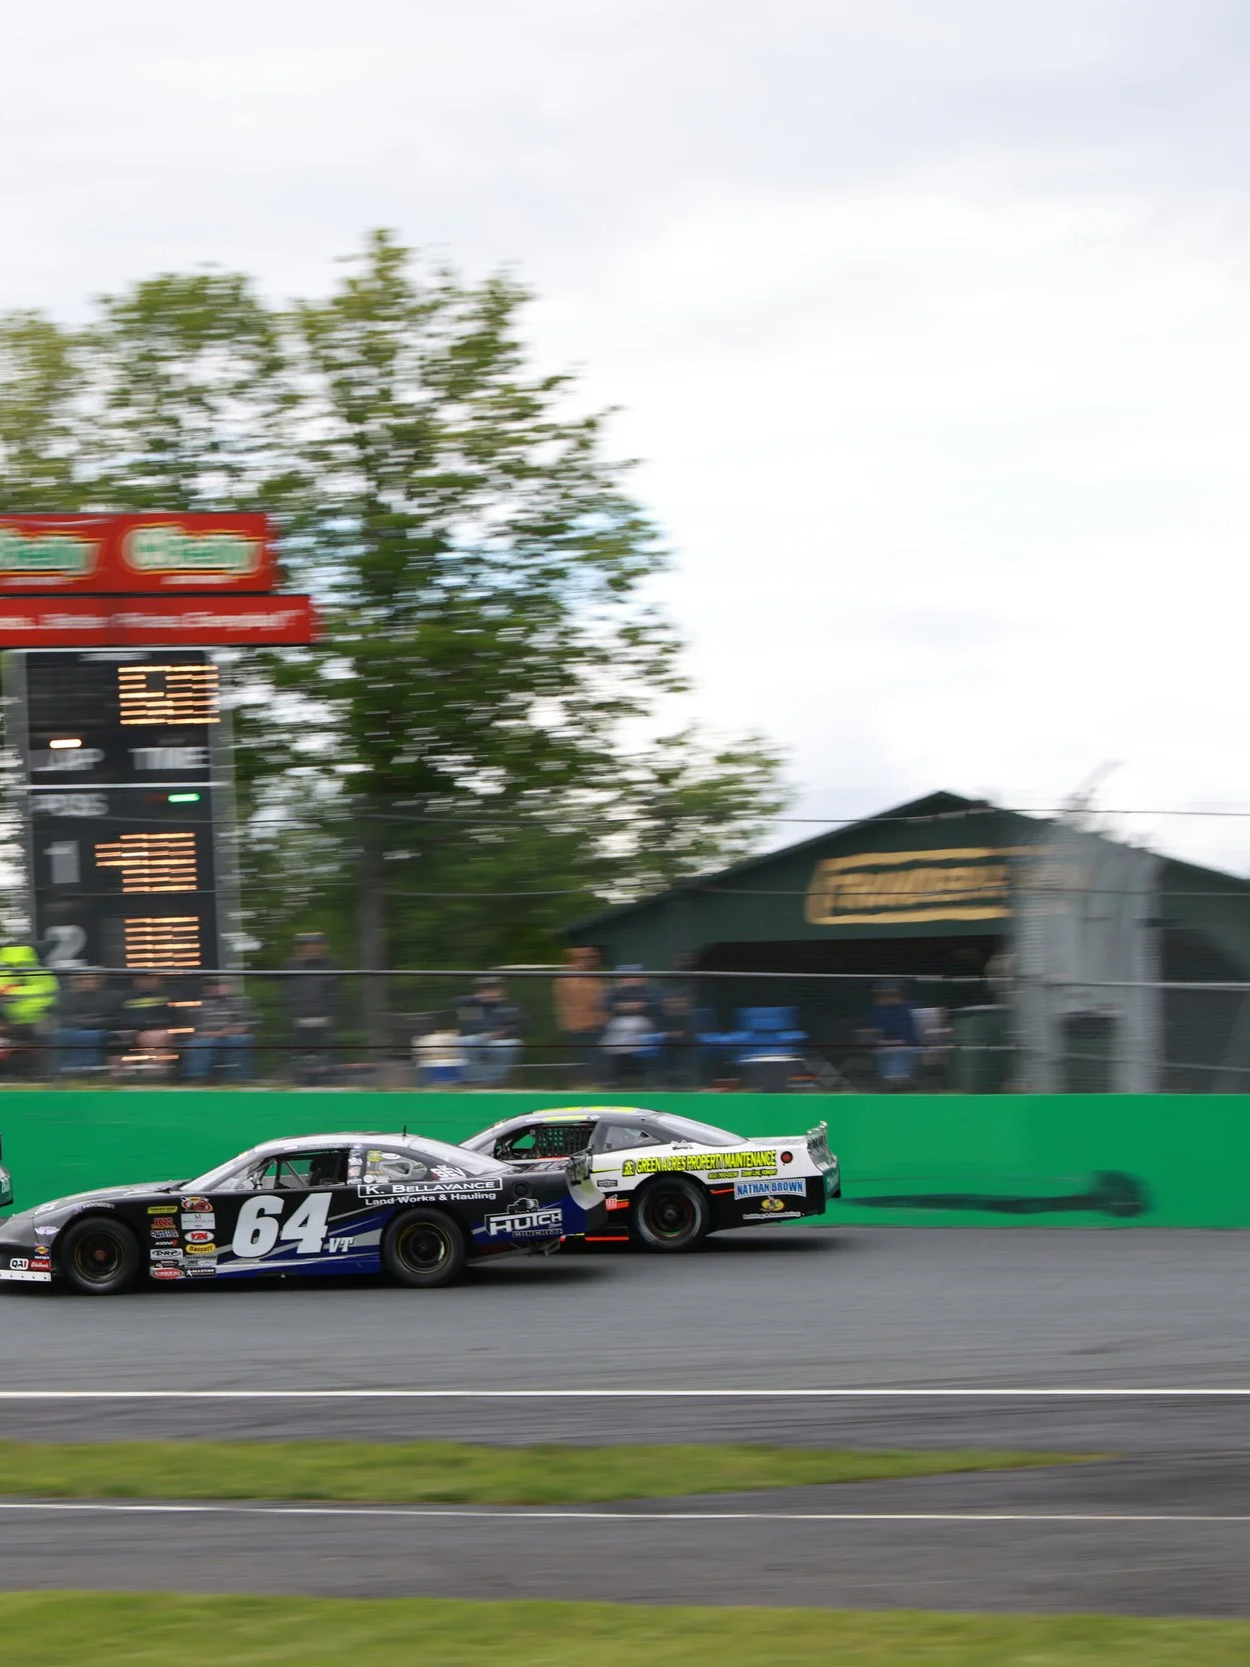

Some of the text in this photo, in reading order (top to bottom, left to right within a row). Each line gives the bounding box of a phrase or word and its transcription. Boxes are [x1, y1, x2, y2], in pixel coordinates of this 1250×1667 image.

[637, 1150, 776, 1174] GREEN ACRES PROPERTY MAINTENANCE
[365, 1185, 385, 1195] K.
[450, 1192, 496, 1200] Hauling
[737, 1181, 803, 1195] NATHAN BROWN
[232, 1192, 354, 1258] 64 VT
[489, 1209, 562, 1235] HUTCH
